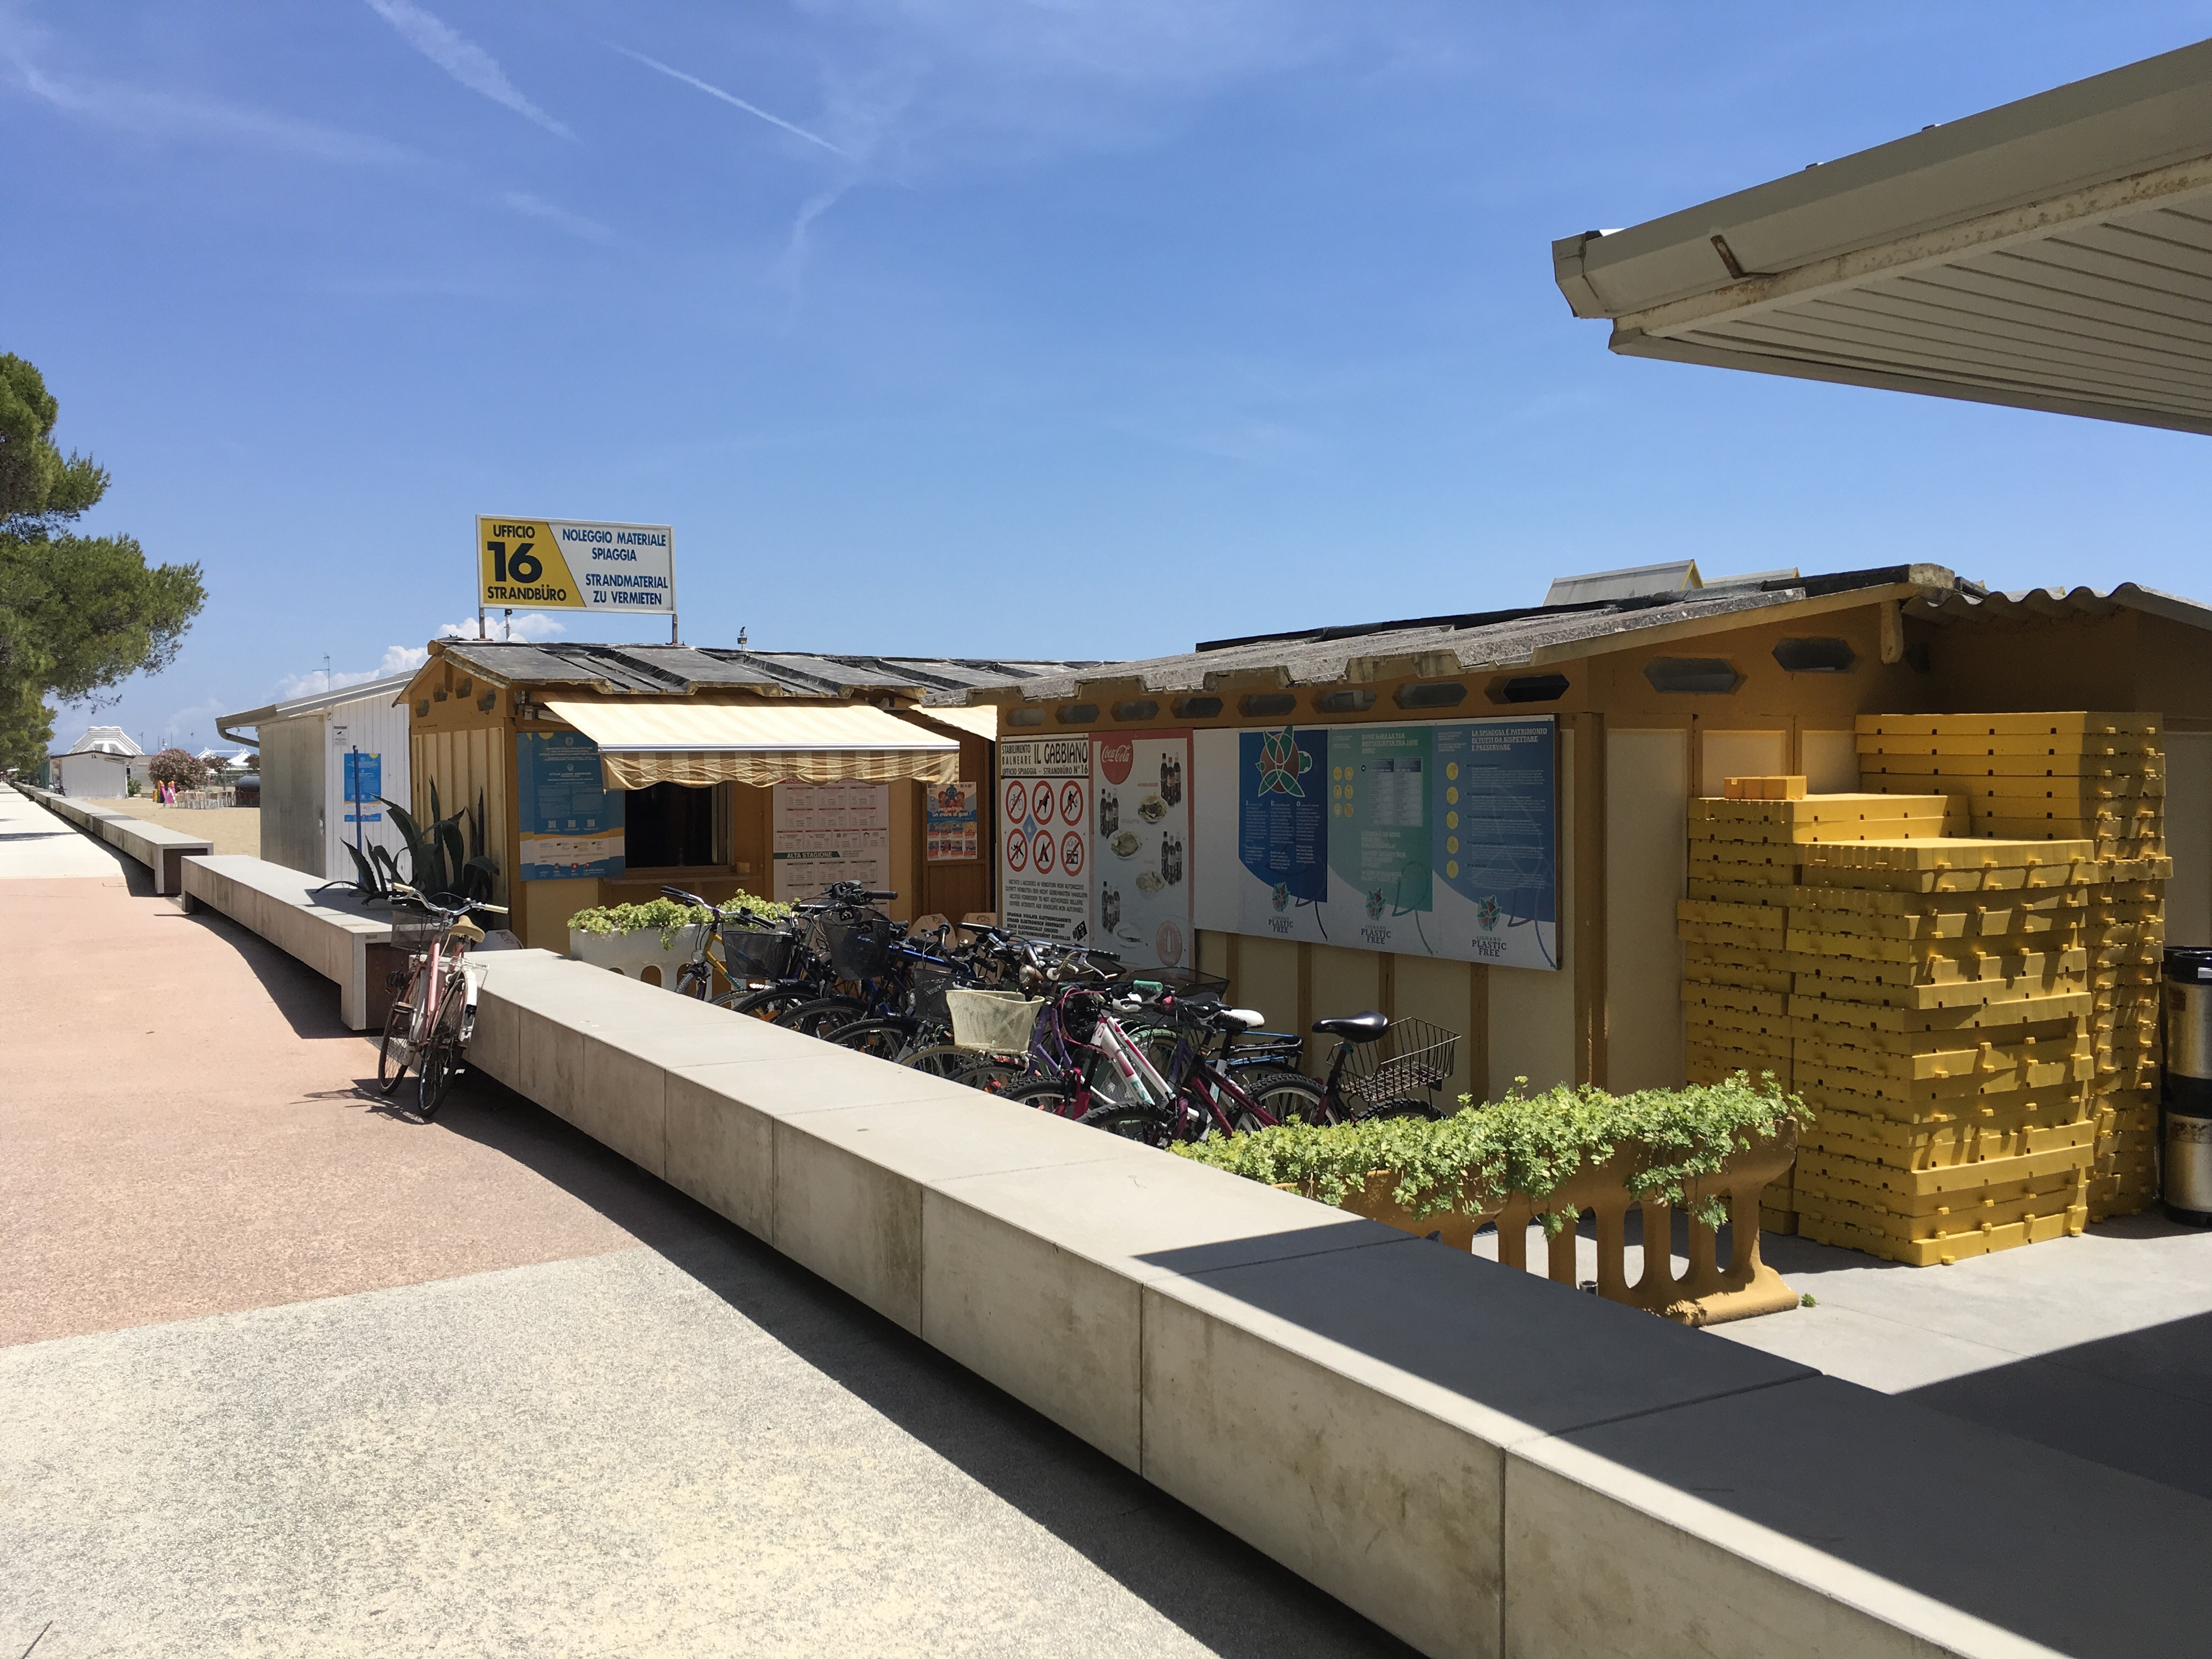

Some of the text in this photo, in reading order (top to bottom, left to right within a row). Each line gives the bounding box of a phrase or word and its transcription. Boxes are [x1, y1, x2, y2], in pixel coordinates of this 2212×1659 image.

[493, 524, 535, 539] UFFICIO
[562, 528, 666, 547] NOLEGGIO MATERIALE
[591, 548, 637, 561] SPIAGGIA
[487, 541, 543, 584] 16
[585, 573, 668, 589] STRANDMATERIAL
[487, 584, 566, 602] STRANDBÜRO
[593, 590, 662, 605] ZU VERMIETEN
[1002, 744, 1031, 754] STABILIMENTO
[1034, 742, 1088, 764] IL GABBIANO
[1002, 755, 1031, 765] BALNEARE
[1043, 765, 1072, 775] STRANDBÜRO
[1268, 919, 1294, 928] PLASTIC
[1361, 928, 1391, 938] PLASTIC
[1367, 936, 1385, 945] FREE
[1472, 939, 1506, 950] PLASTIC
[1479, 948, 1500, 957] FREE
